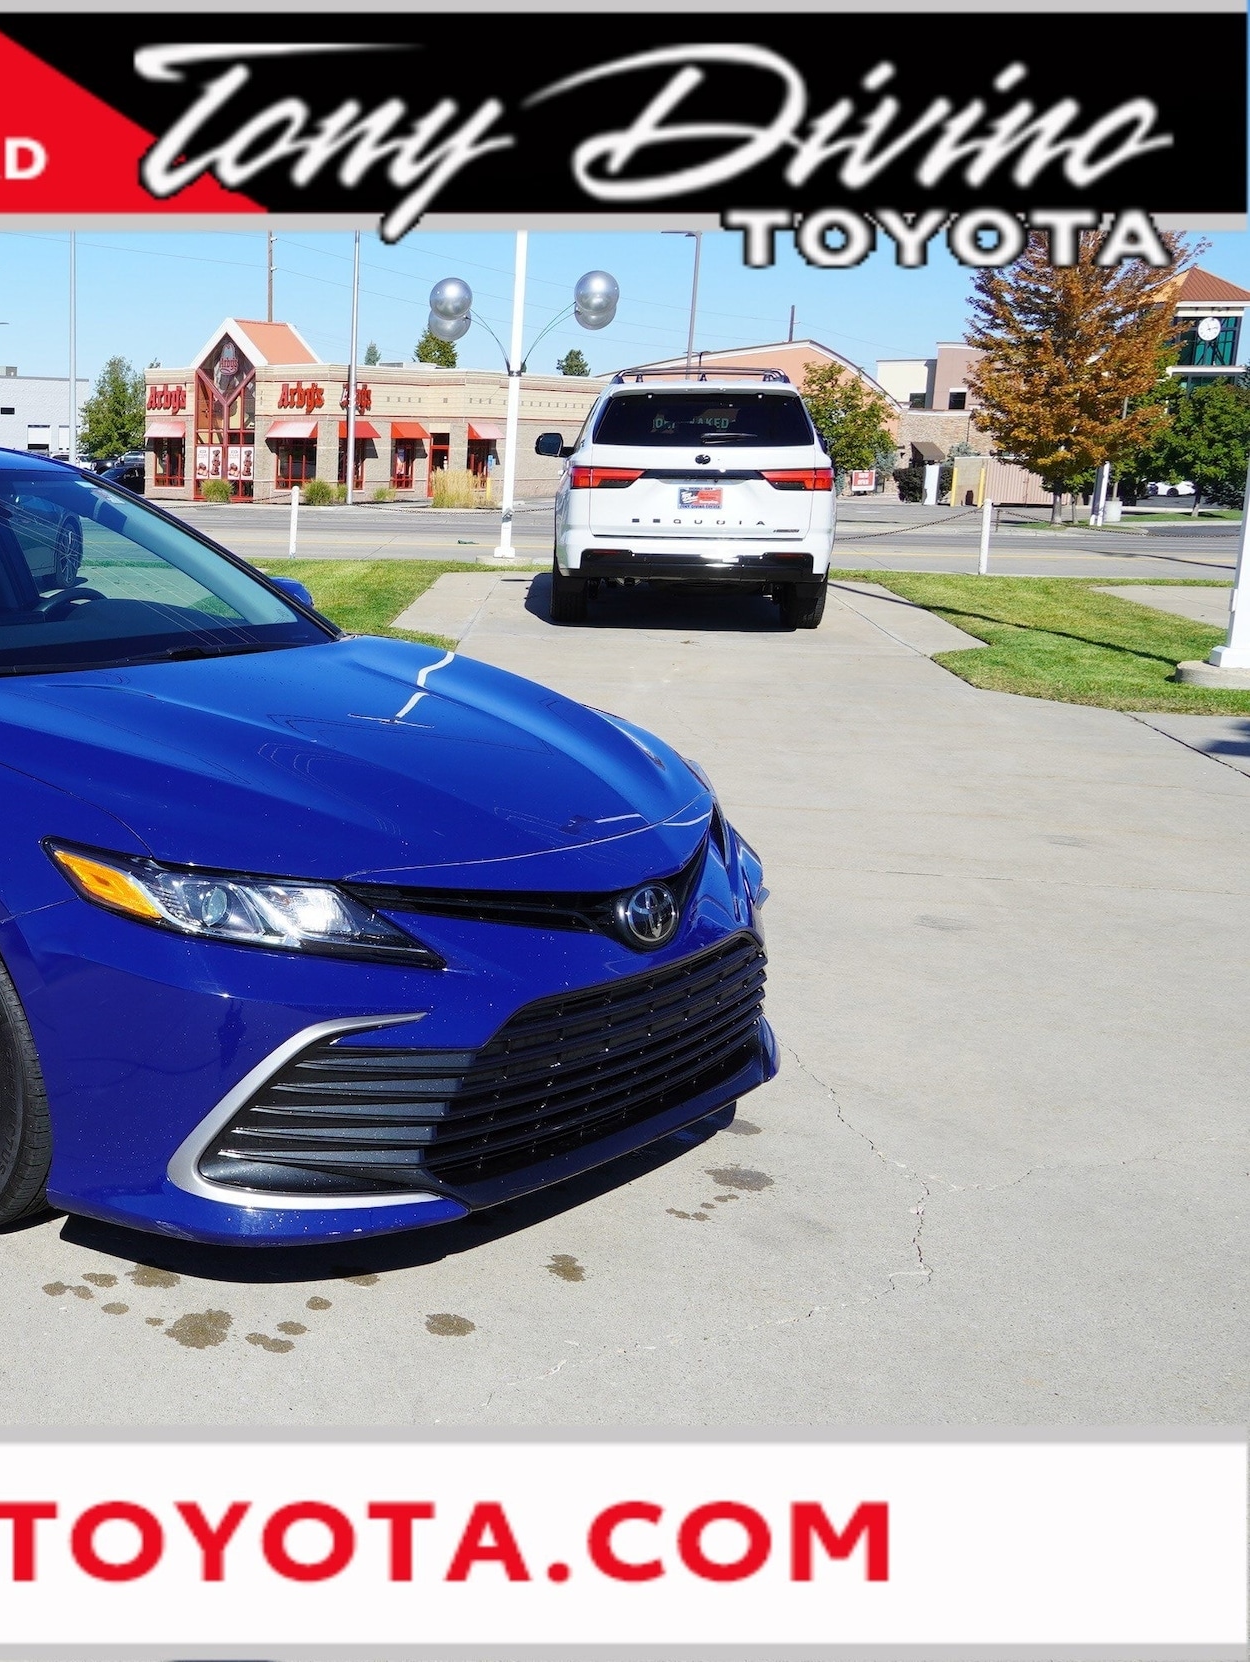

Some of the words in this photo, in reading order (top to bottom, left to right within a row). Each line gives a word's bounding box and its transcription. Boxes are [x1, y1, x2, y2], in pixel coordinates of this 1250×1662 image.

[147, 384, 187, 415] Arby's
[278, 382, 325, 415] Arby's
[631, 518, 765, 526] SEQUOIA
